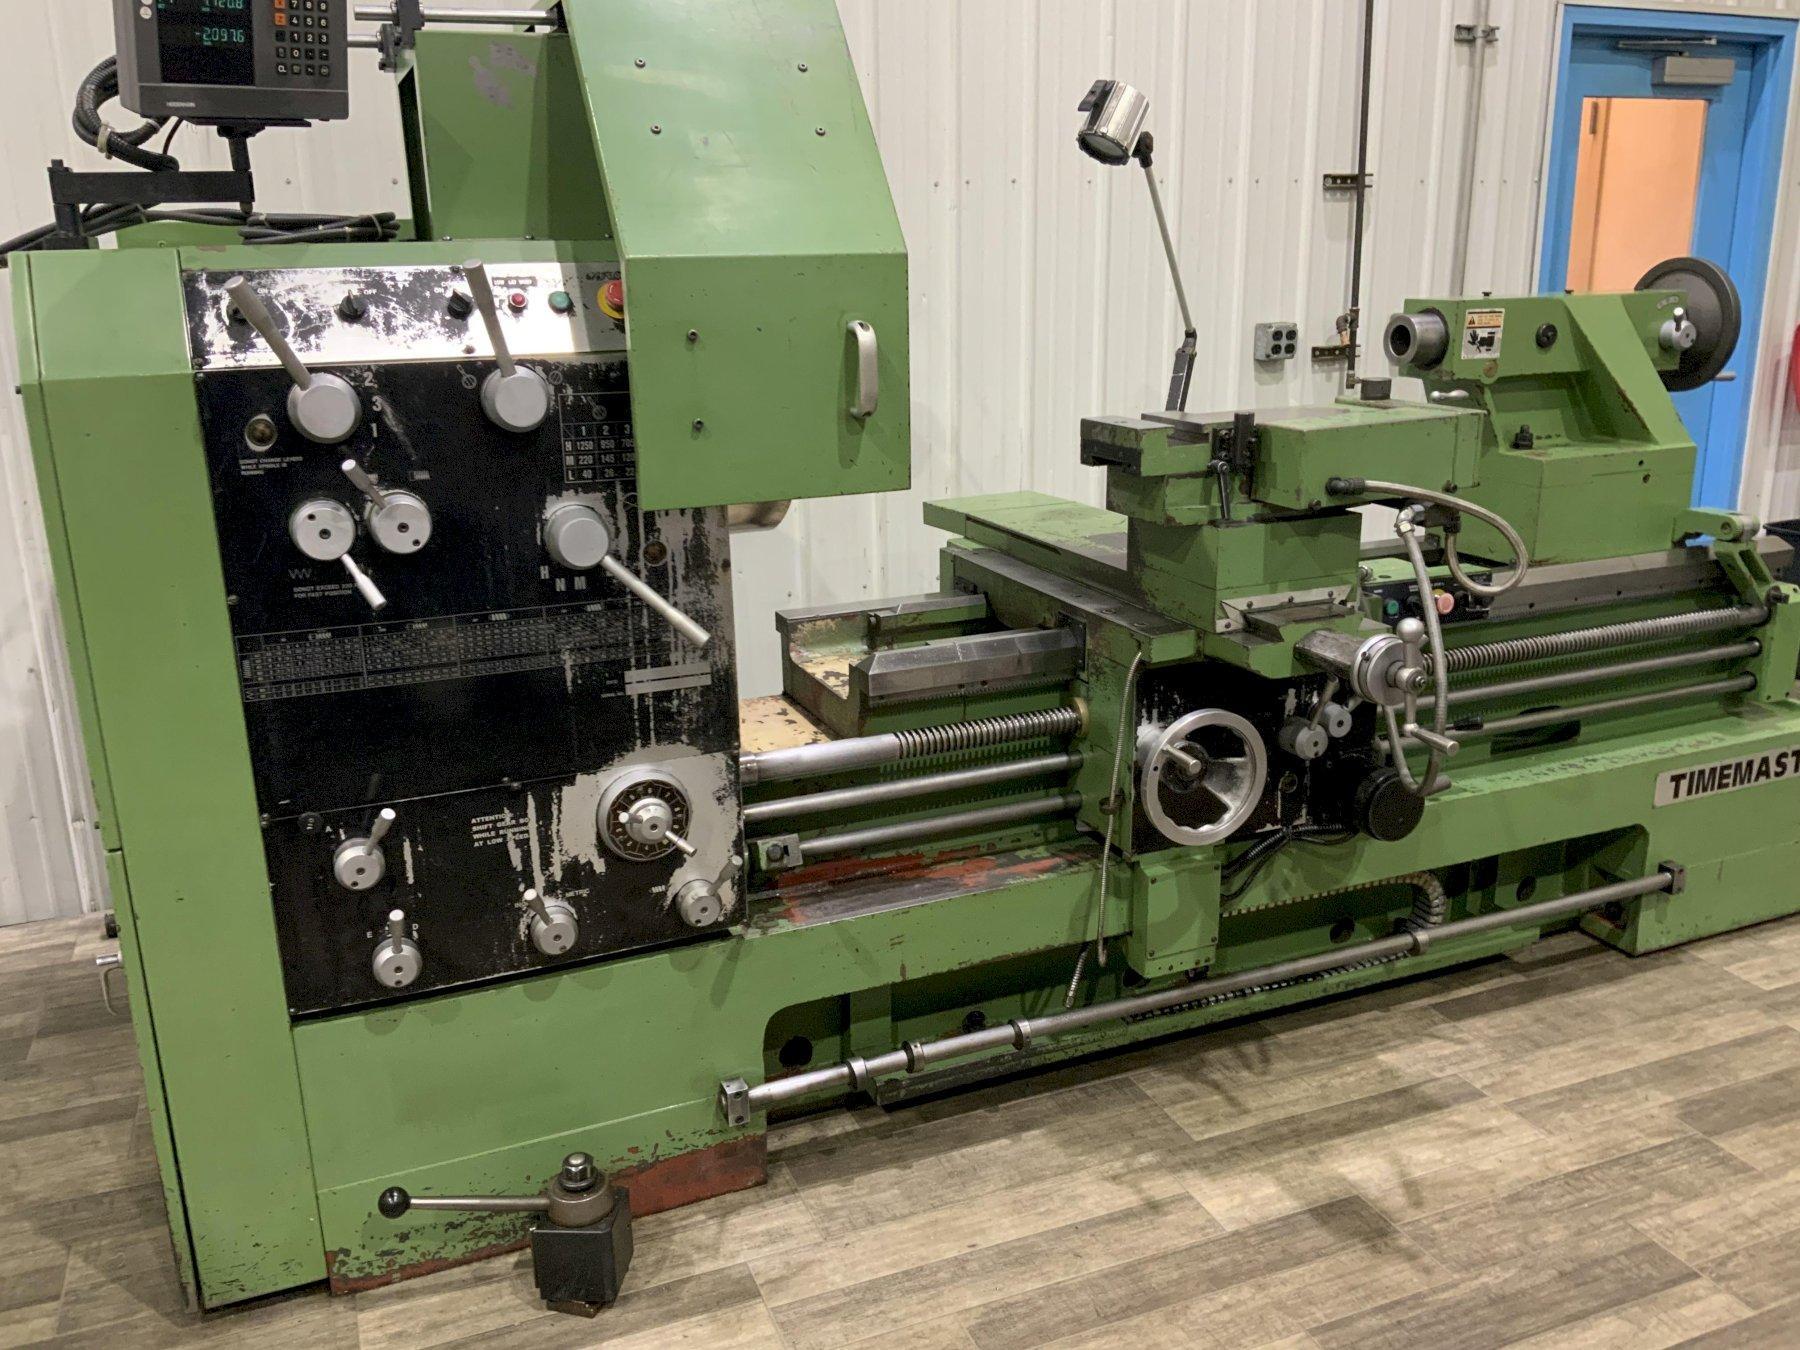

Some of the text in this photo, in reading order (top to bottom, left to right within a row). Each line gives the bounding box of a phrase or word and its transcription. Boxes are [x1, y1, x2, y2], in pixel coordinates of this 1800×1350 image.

[291, 0, 298, 8] 7
[292, 16, 298, 24] 4
[320, 18, 326, 27] 6
[293, 33, 327, 43] 1 2 3
[293, 49, 299, 57] 0
[363, 371, 374, 387] 2
[371, 395, 382, 412] 3
[371, 422, 378, 438] 1
[581, 424, 631, 436] 1 2 3
[565, 455, 574, 466] M
[578, 454, 593, 465] 220
[567, 469, 575, 481] L
[540, 565, 549, 580] H
[574, 575, 586, 591] M
[473, 831, 496, 840] WHILE
[487, 838, 503, 846] LOW
